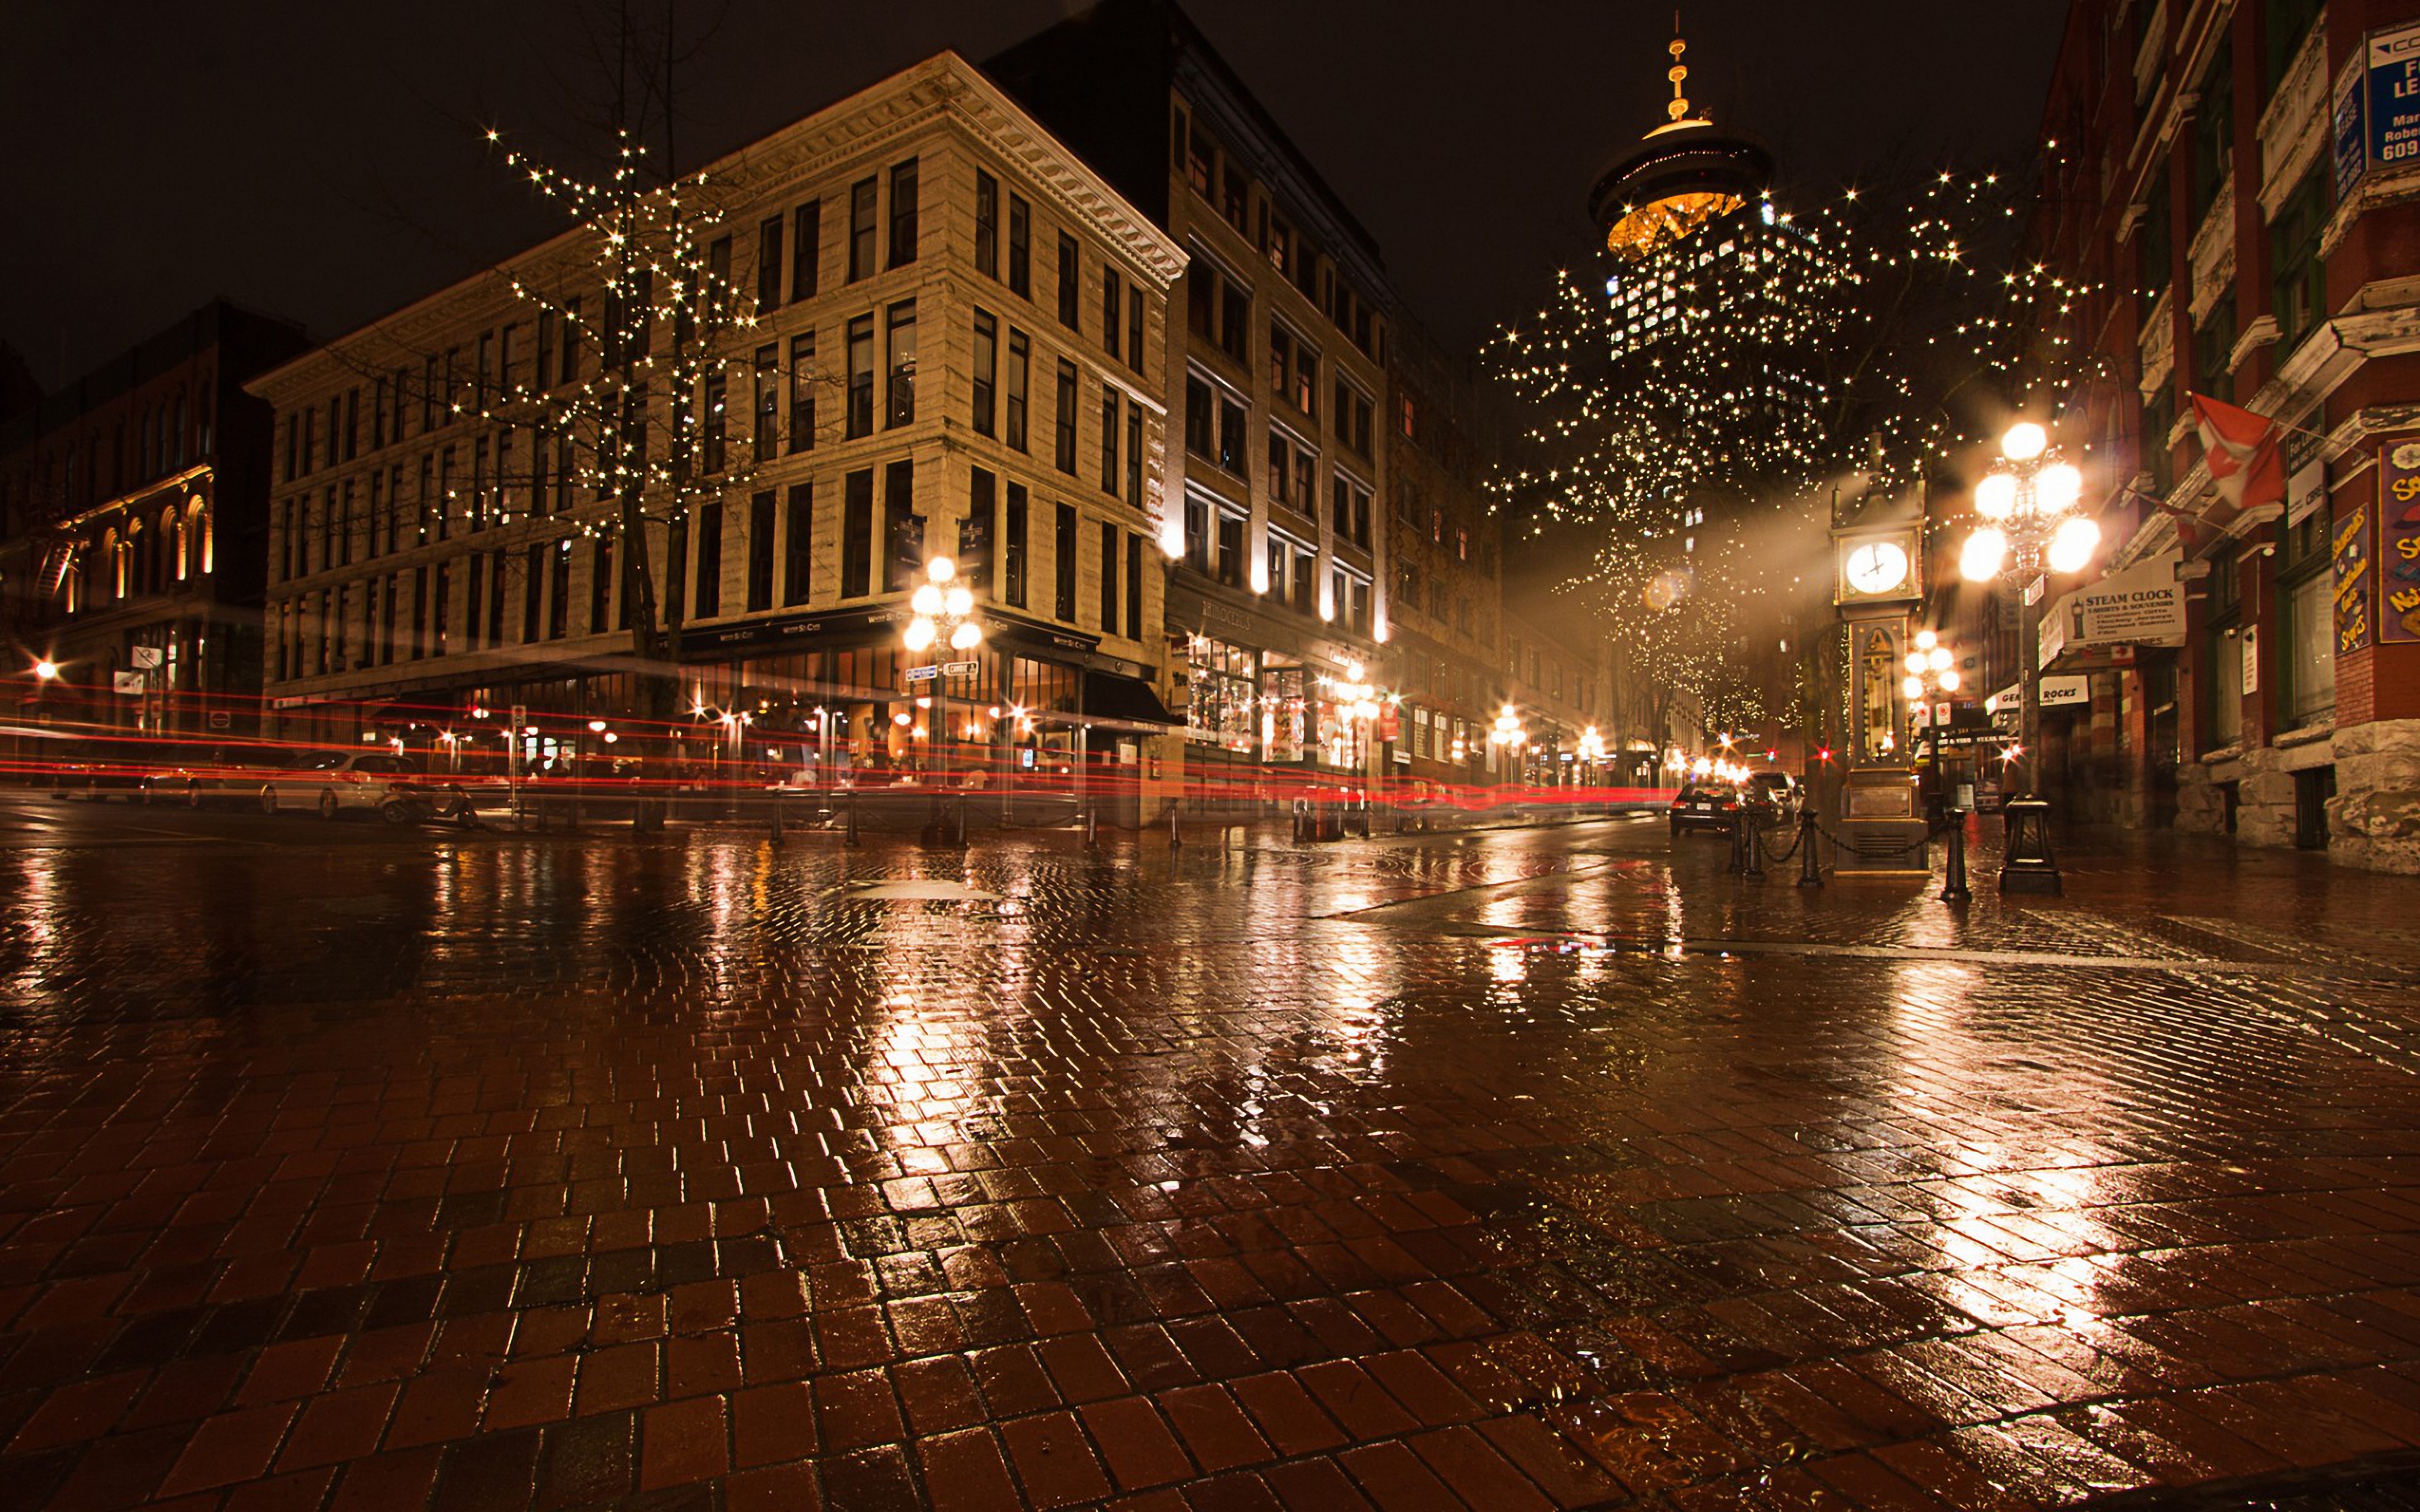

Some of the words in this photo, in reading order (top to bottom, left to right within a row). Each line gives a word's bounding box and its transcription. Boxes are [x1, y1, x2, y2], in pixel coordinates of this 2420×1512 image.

[2405, 60, 2420, 78] F
[2086, 594, 2127, 606] STEAM
[2132, 589, 2173, 602] CLOCK
[2044, 688, 2076, 699] ROCKS
